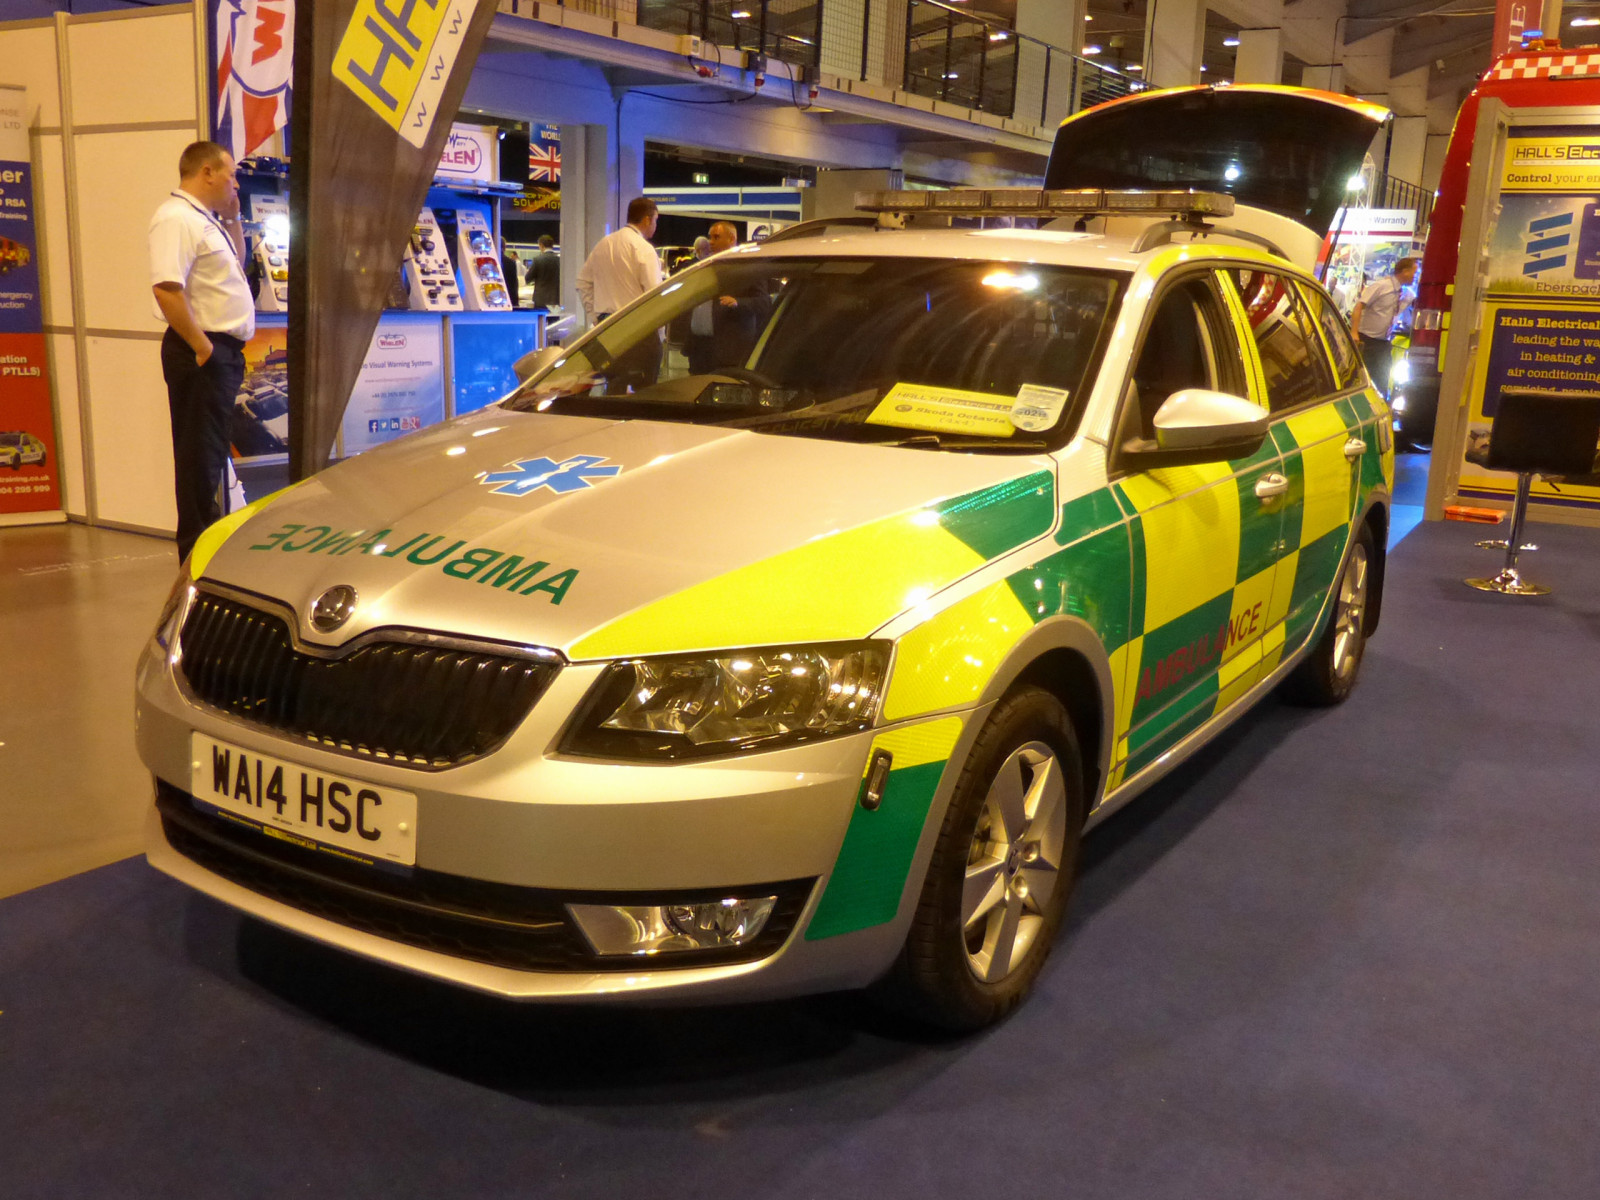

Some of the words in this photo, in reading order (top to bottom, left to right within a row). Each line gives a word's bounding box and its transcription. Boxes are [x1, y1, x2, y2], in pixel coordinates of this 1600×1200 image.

[0, 170, 24, 183] er
[1507, 173, 1552, 183] Control
[1554, 174, 1583, 184] your
[5, 198, 25, 207] RSA
[1373, 217, 1408, 225] Warranty
[1536, 282, 1600, 295] Eberspac
[1500, 316, 1534, 327] Halls
[1537, 318, 1600, 330] Electrical
[1513, 333, 1558, 347] leading
[1560, 336, 1580, 346] the
[387, 361, 410, 369] Warning
[411, 360, 433, 368] Systems
[1520, 351, 1532, 361] in
[1535, 352, 1582, 365] heating
[1584, 354, 1596, 364] &
[3, 367, 41, 377] PTLLS)
[1507, 368, 1525, 377] air
[915, 407, 954, 417] Skoda
[957, 413, 1006, 424] Octavia
[1134, 600, 1263, 708] AMBULANCE
[300, 772, 383, 841] HSC
